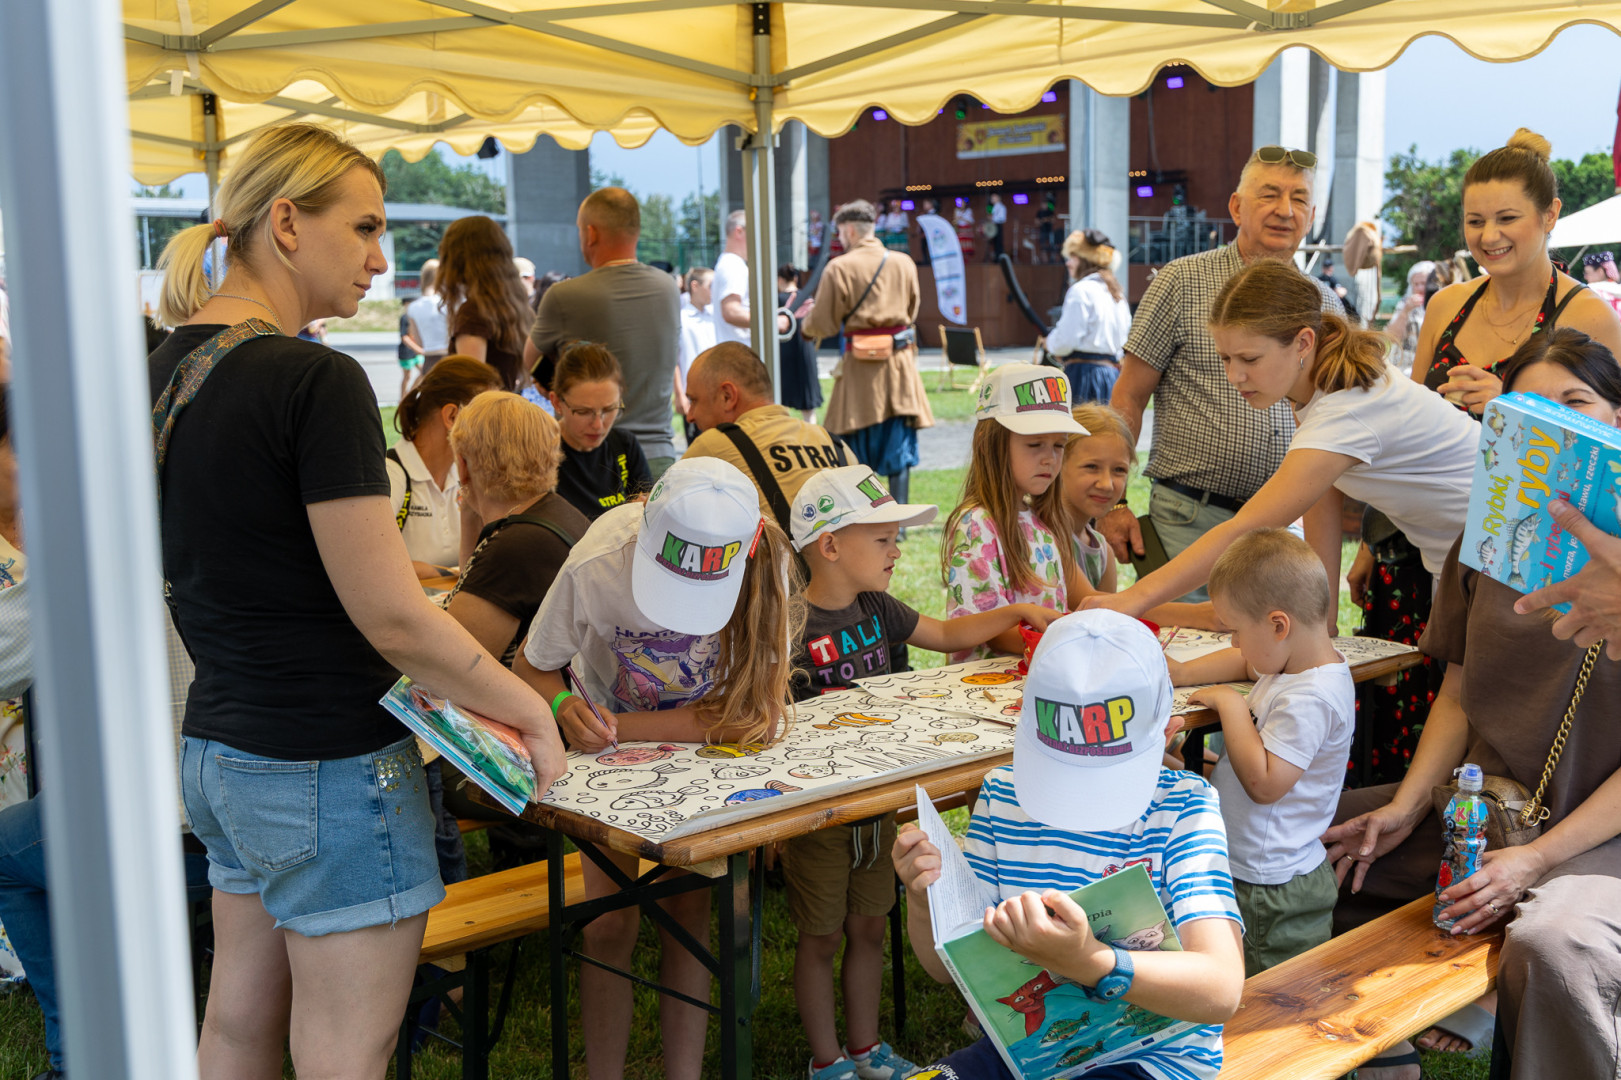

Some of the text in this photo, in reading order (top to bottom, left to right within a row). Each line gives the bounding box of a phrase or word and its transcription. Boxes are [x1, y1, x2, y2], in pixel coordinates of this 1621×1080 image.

[1013, 377, 1067, 406] KARP
[769, 445, 840, 472] STRA
[1516, 426, 1560, 509] ryby
[1482, 474, 1514, 536] Rybki,
[661, 531, 742, 573] KARP
[818, 643, 886, 685] TO TH
[1035, 695, 1135, 745] KARP
[1087, 908, 1113, 922] rpia
